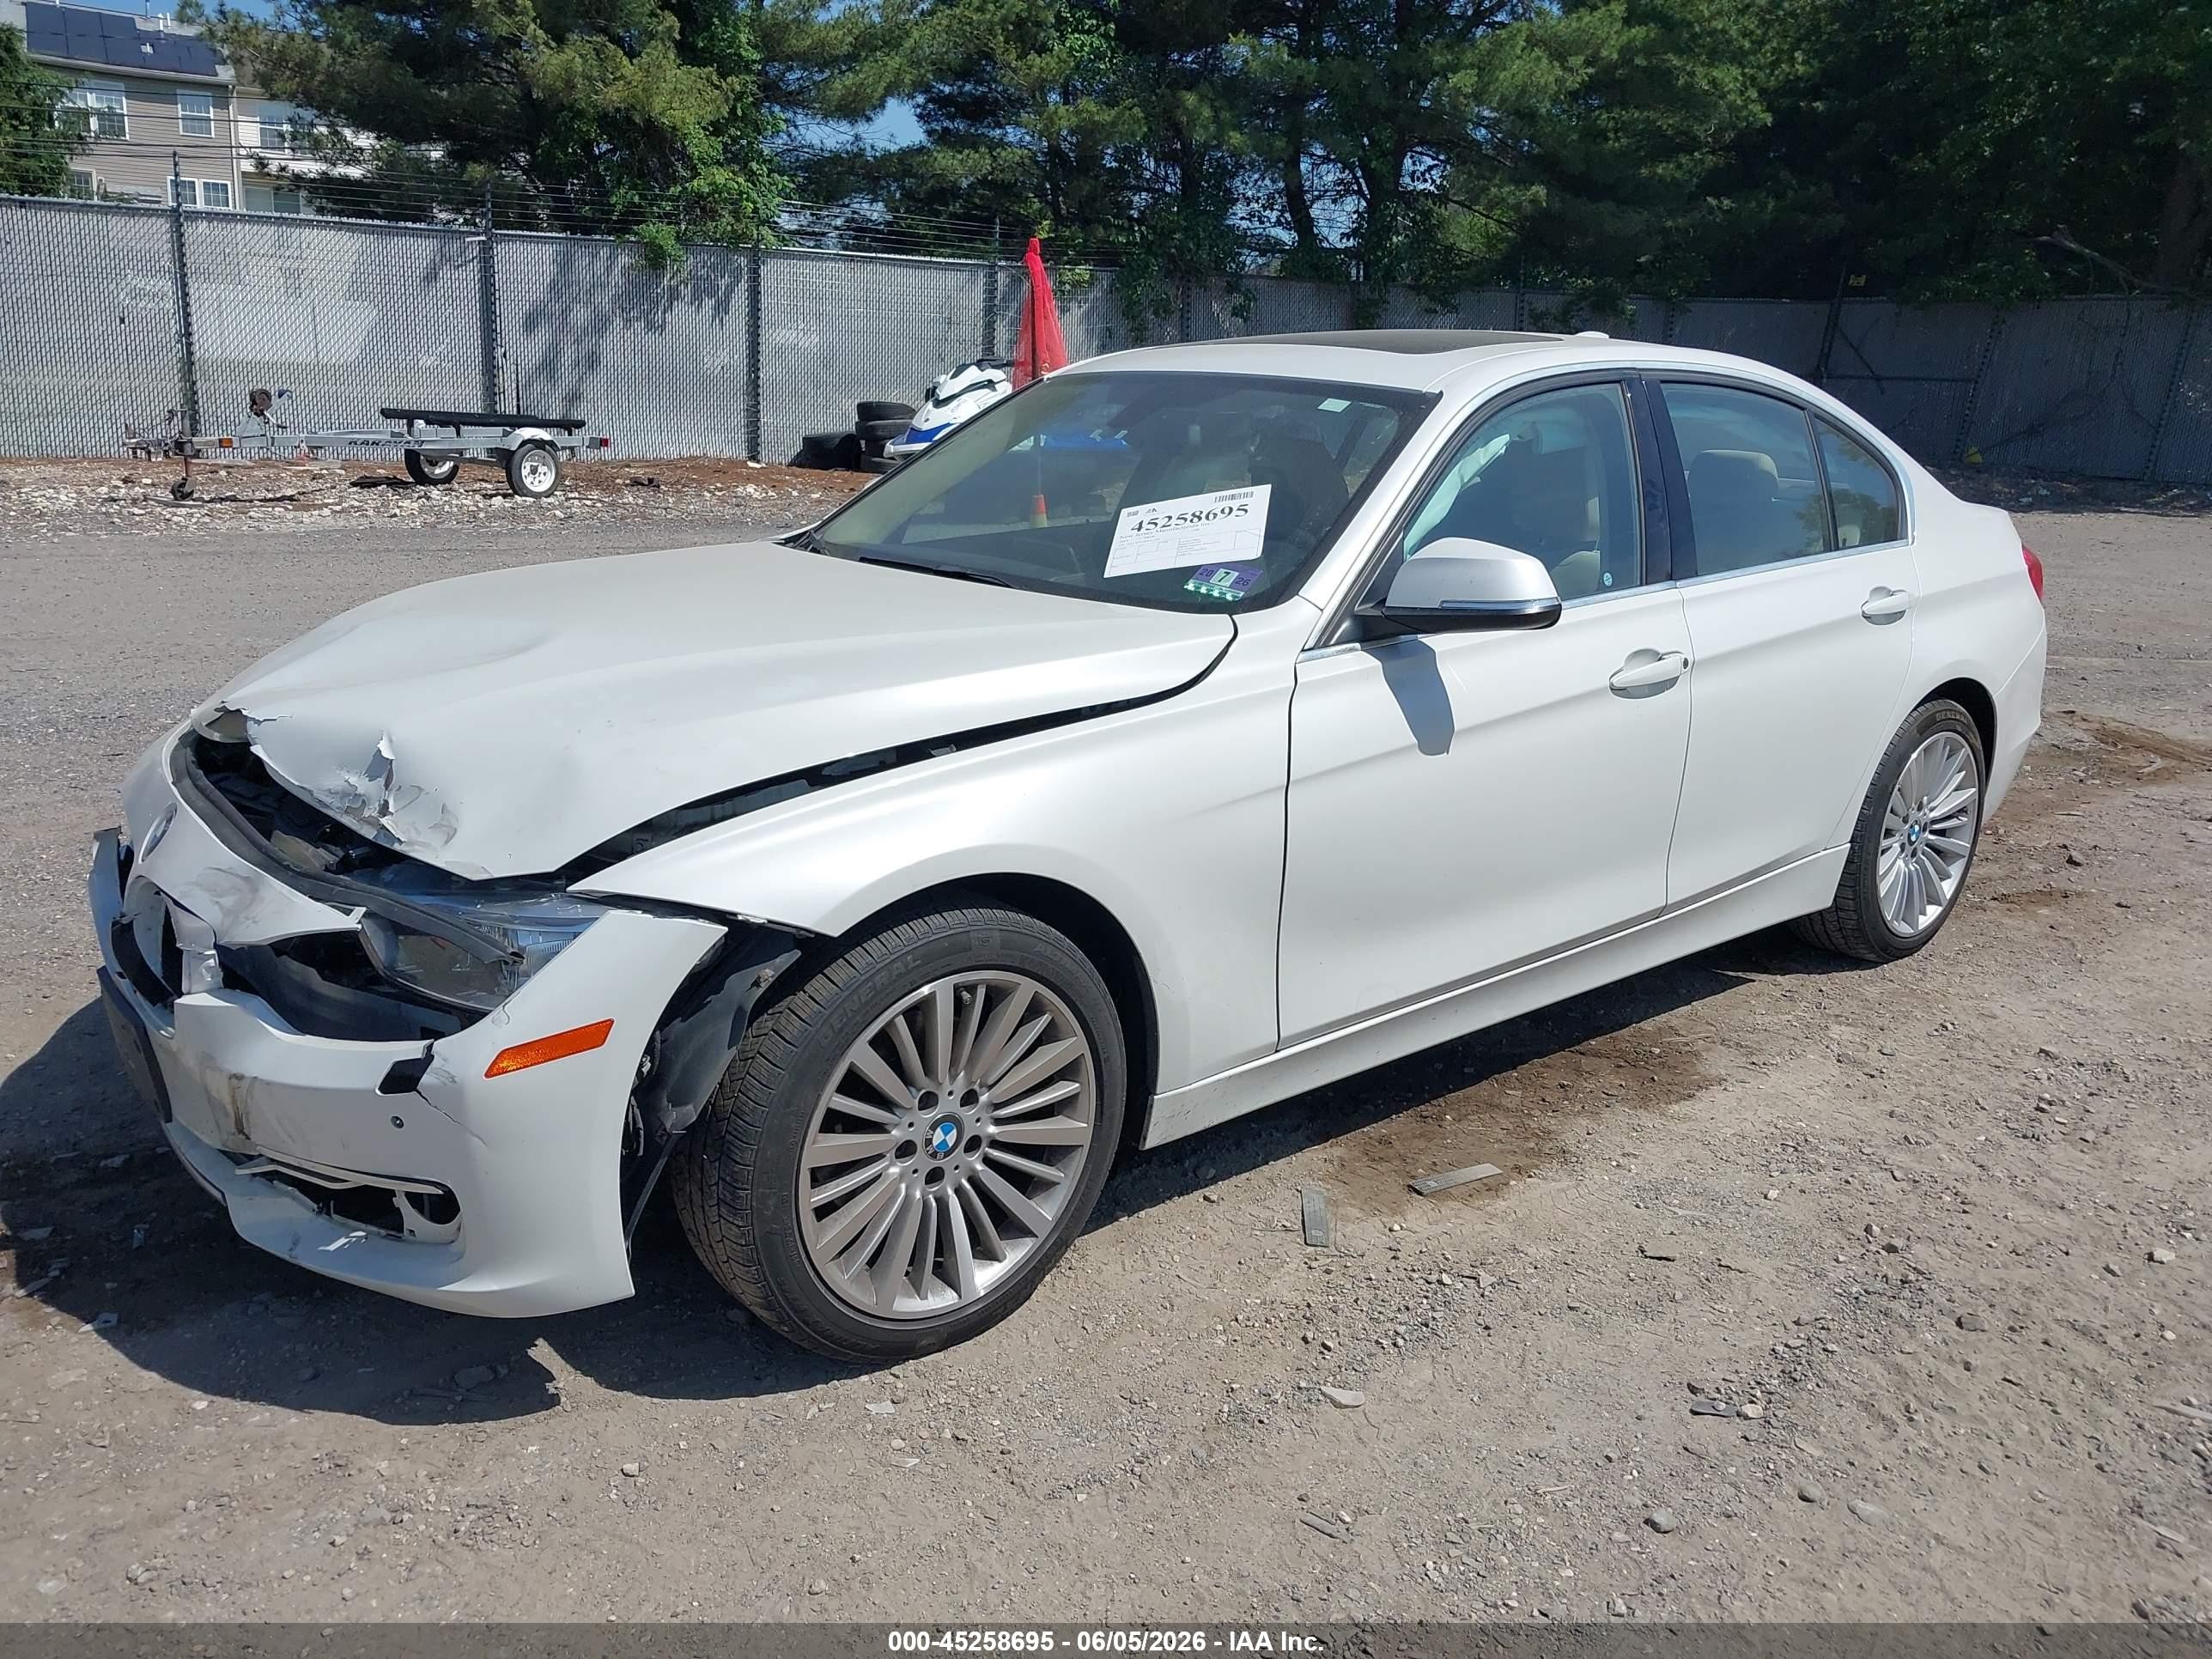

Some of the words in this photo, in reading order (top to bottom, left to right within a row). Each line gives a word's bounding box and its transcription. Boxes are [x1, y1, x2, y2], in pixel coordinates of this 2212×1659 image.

[348, 439, 425, 447] KARAVAN
[1130, 503, 1249, 532] 45258695
[1199, 568, 1214, 577] 20
[1218, 571, 1231, 583] 7
[1235, 577, 1251, 586] 26
